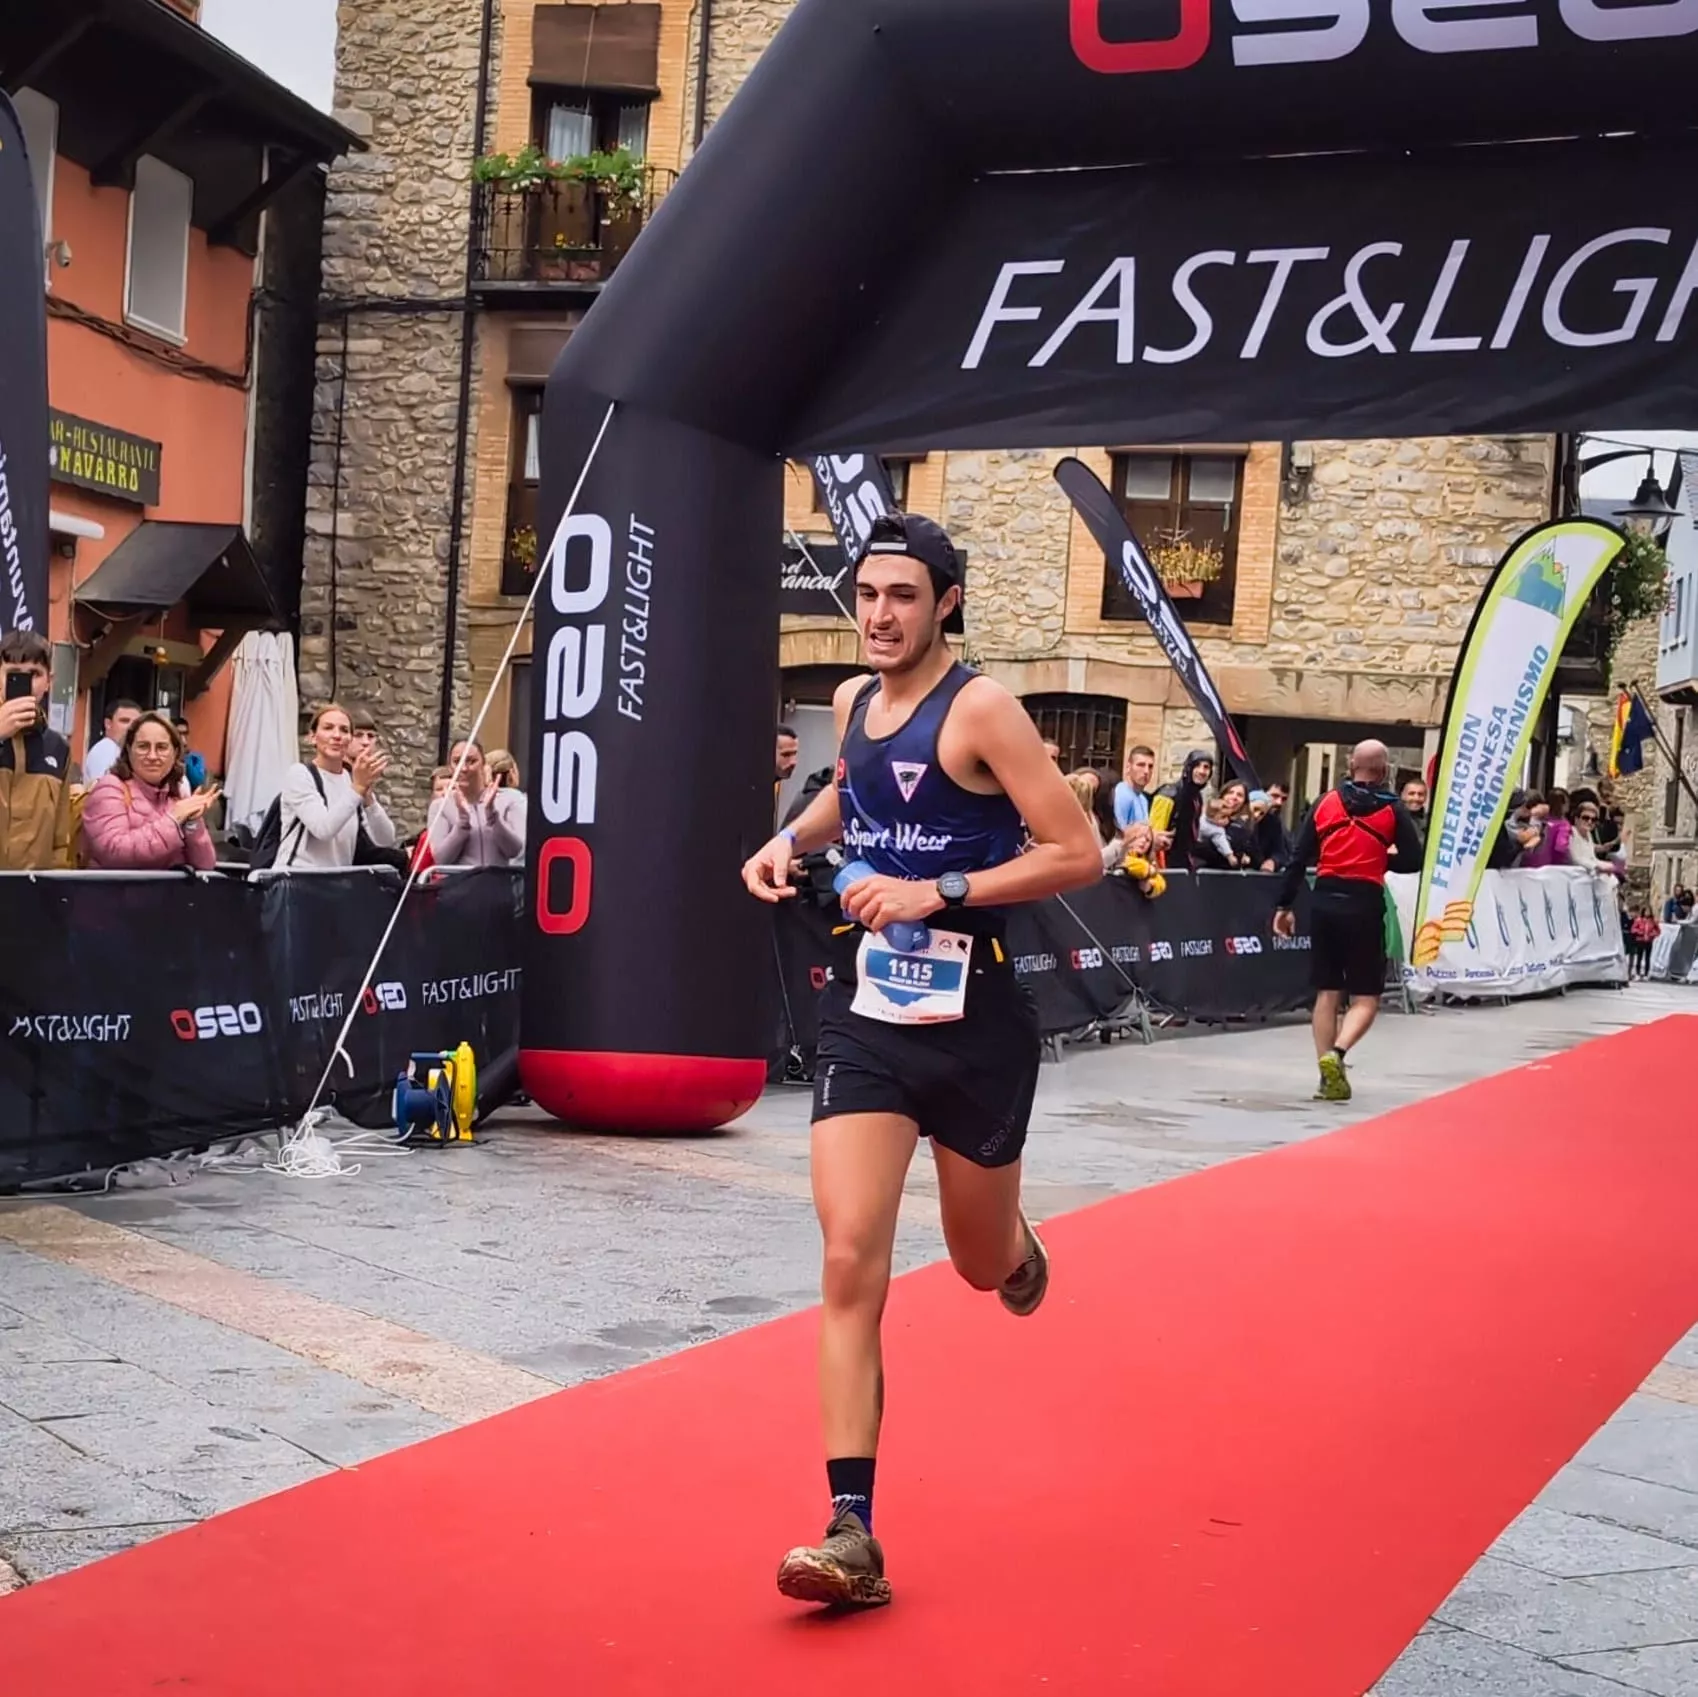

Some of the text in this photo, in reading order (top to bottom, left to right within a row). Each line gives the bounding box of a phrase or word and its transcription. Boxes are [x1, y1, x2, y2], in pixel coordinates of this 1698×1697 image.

[59, 446, 139, 492] NAVARRO
[617, 513, 655, 721] FAST&LIGHT
[1455, 705, 1508, 866] ARAGONESA
[895, 821, 952, 851] Wear
[888, 958, 933, 981] 1115
